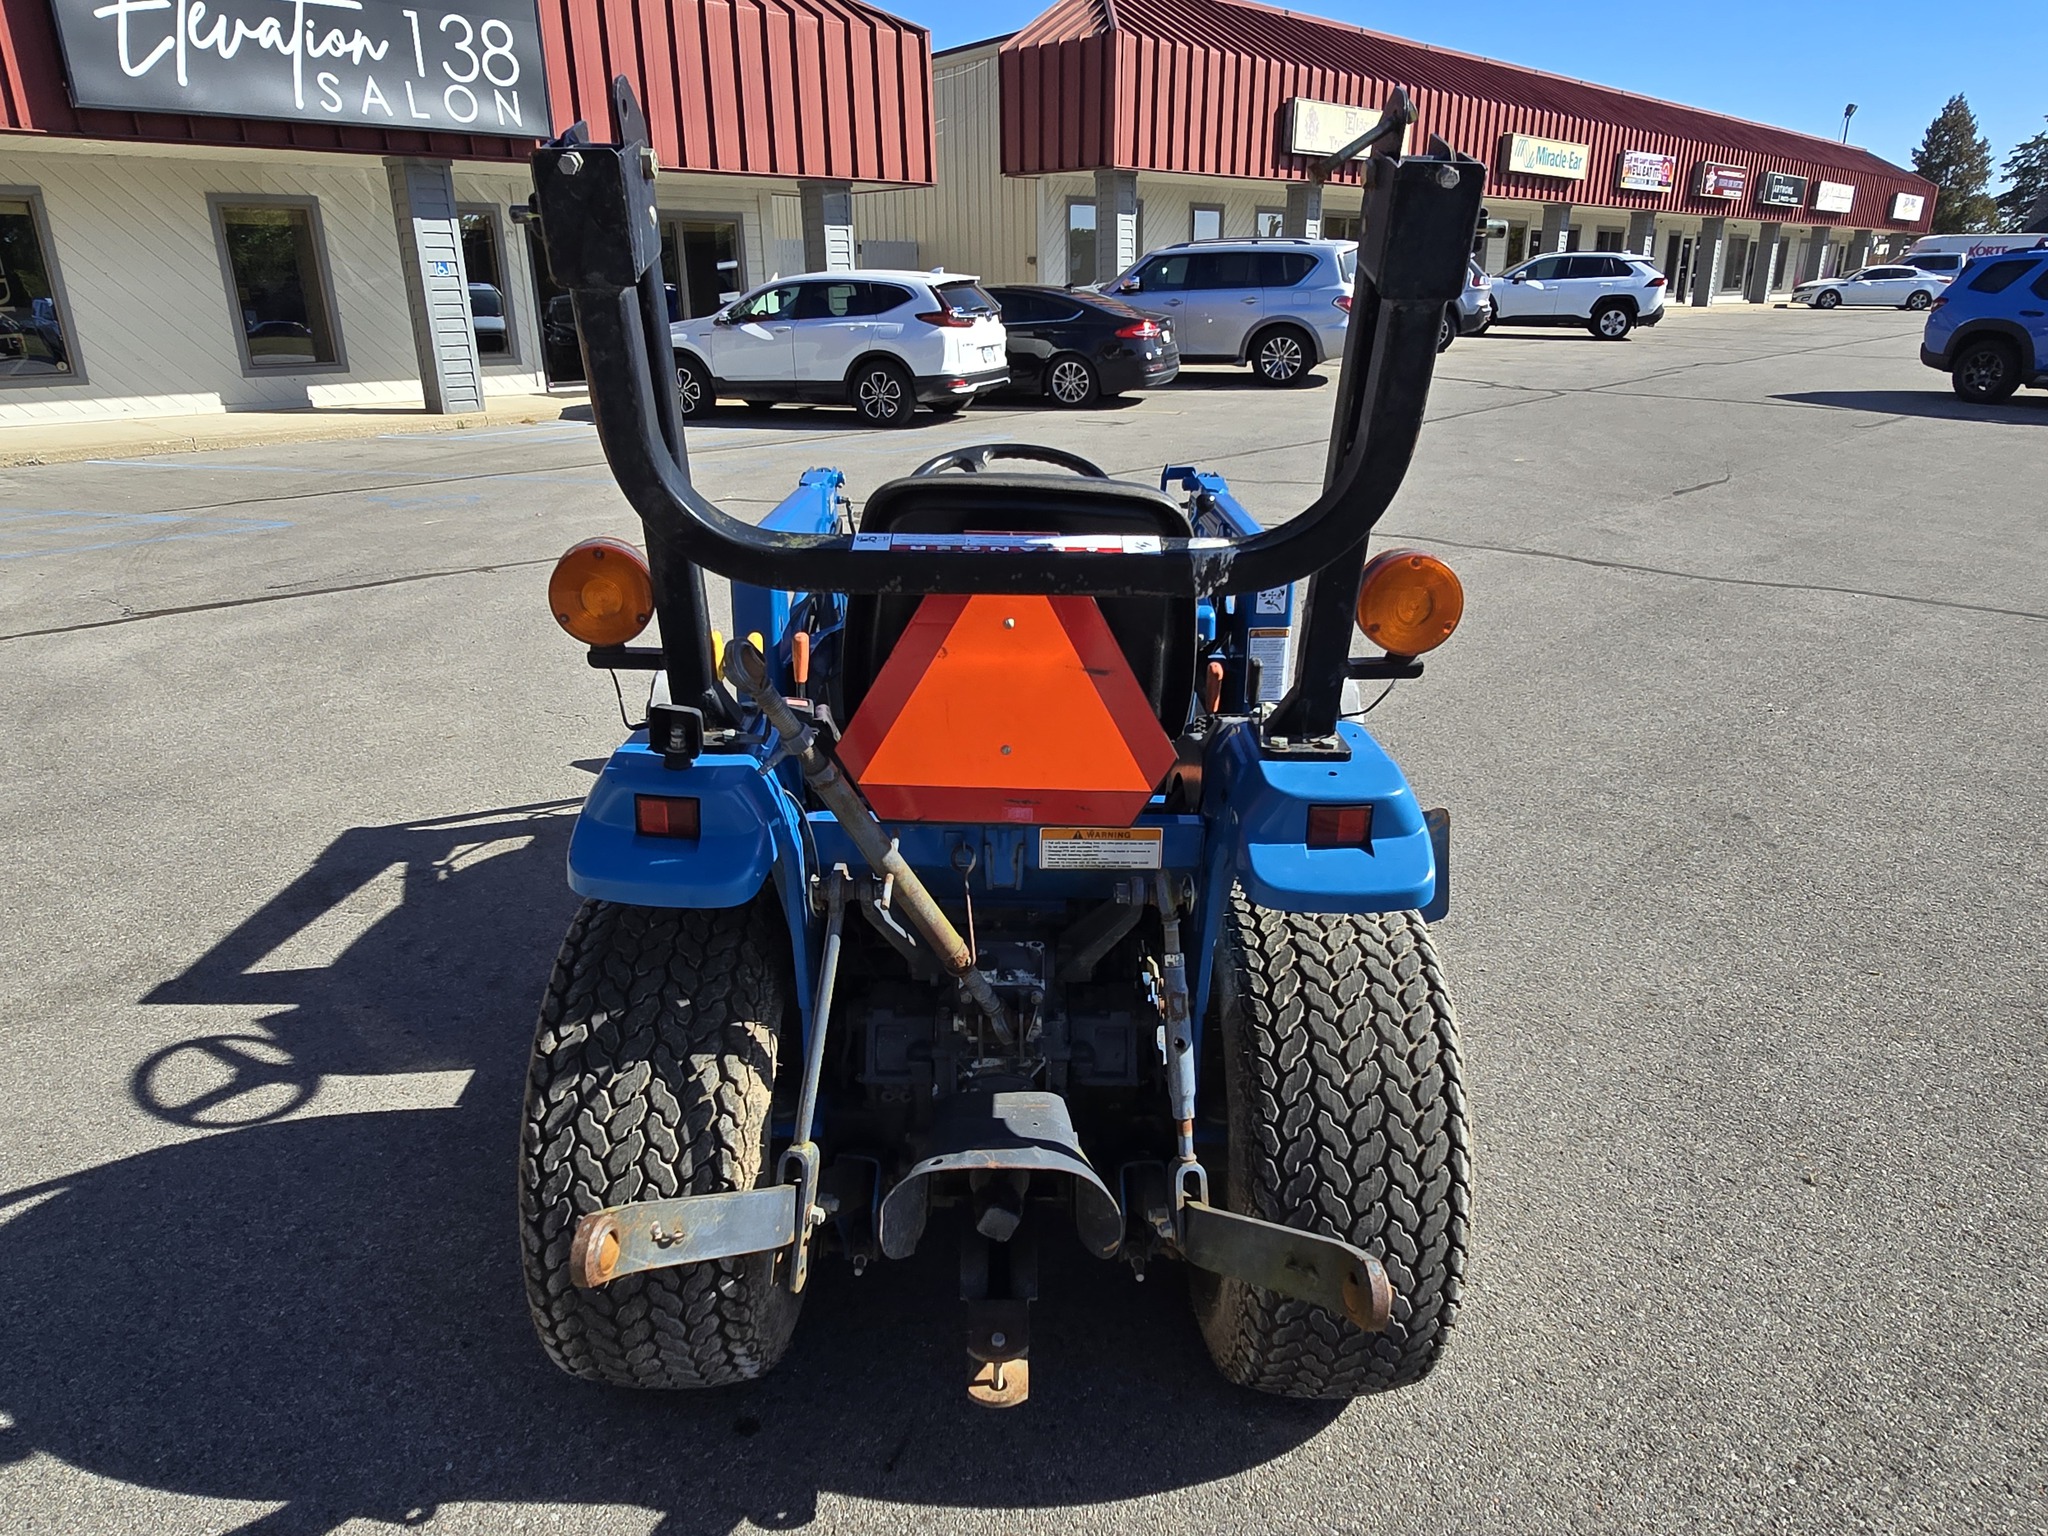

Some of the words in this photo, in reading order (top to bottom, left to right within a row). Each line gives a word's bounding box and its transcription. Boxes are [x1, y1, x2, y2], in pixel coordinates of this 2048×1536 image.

[94, 0, 389, 110] Elevation
[403, 9, 521, 87] 138
[320, 71, 523, 128] SALON
[1086, 831, 1131, 839] WARNING
